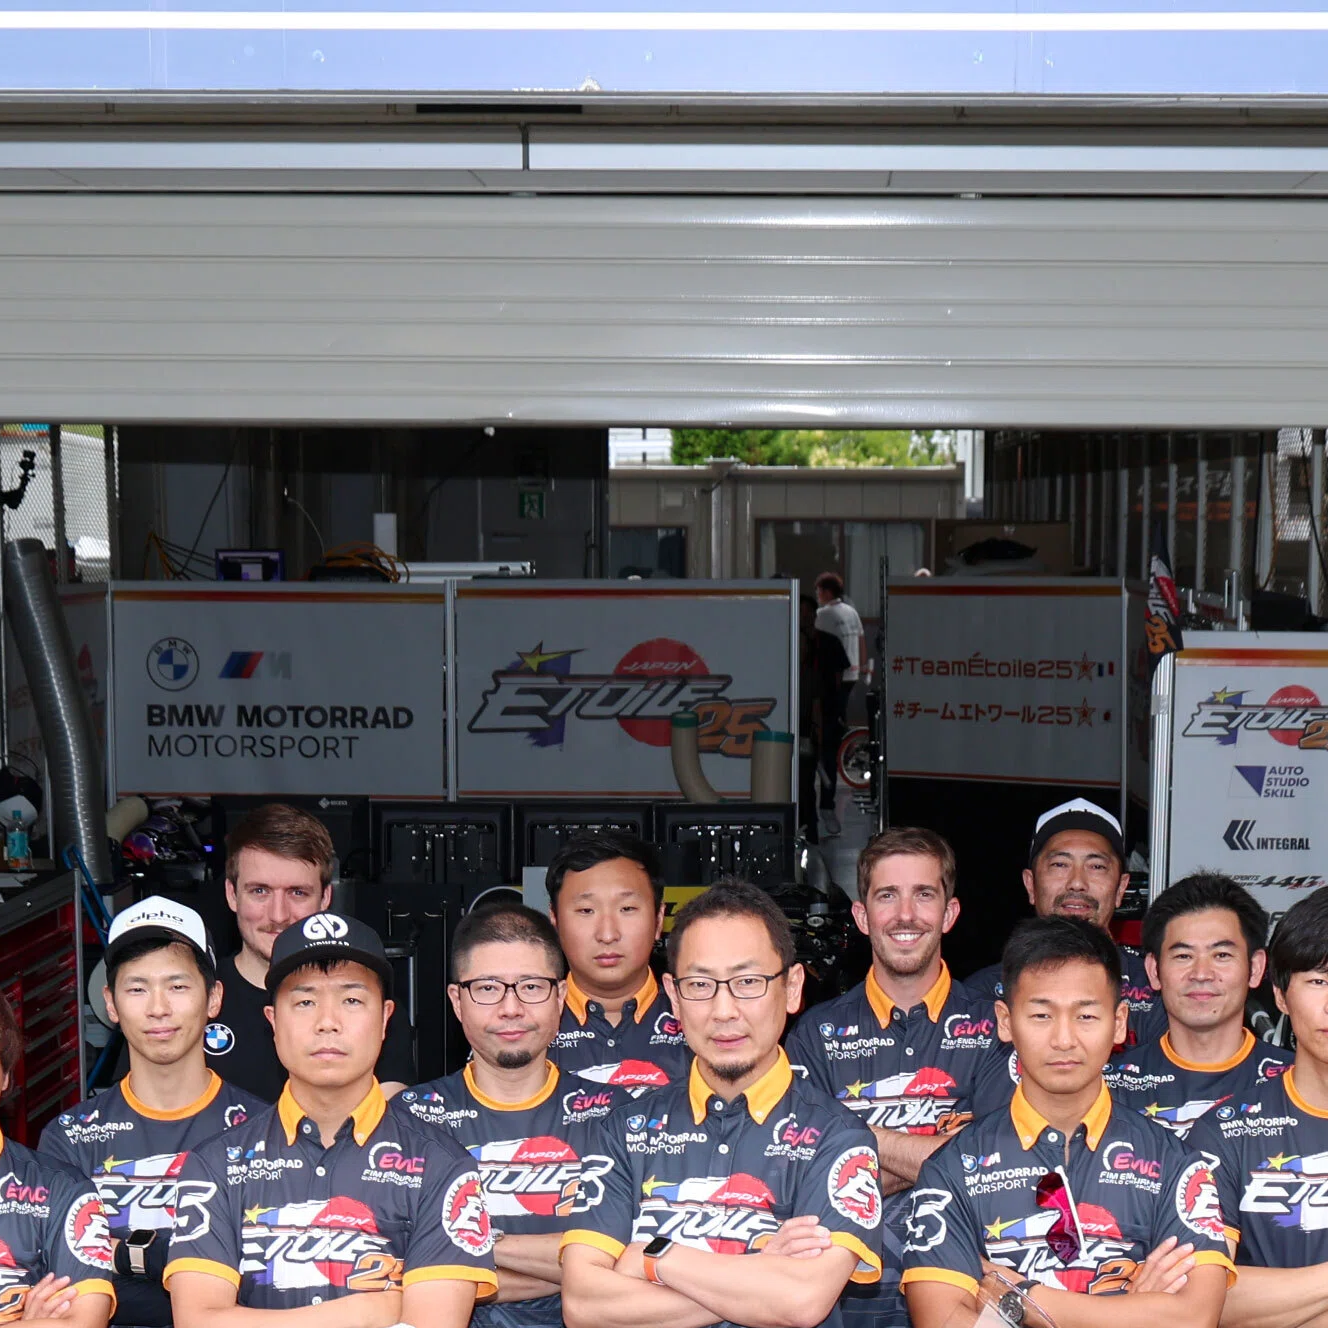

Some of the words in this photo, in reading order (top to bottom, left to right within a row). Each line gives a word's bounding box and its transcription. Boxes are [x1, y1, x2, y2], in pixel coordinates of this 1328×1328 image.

[623, 660, 697, 672] JAPON
[469, 670, 732, 731] ETOILE
[1274, 695, 1314, 705] JAPON
[146, 704, 224, 726] BMW
[236, 705, 413, 729] MOTORRAD
[147, 734, 359, 759] MOTORSPORT
[1268, 766, 1304, 776] AUTO
[1265, 778, 1310, 788] STUDIO
[1263, 789, 1296, 800] SKILL
[1256, 838, 1310, 851] INTEGRAL
[131, 910, 184, 923] alpha
[841, 1038, 895, 1051] MOTORRAD
[614, 1071, 662, 1082] JPON
[1123, 1074, 1175, 1084] MOTORRAD
[909, 1081, 953, 1093] JPON
[517, 1149, 569, 1161] JAPON
[378, 1152, 425, 1174] EWC
[1113, 1152, 1161, 1179] EWC
[478, 1163, 582, 1195] TOILE
[981, 1166, 1049, 1184] MOTORRAD
[5, 1182, 49, 1203] EWC
[716, 1193, 766, 1204] JPON
[318, 1213, 374, 1225] JPON
